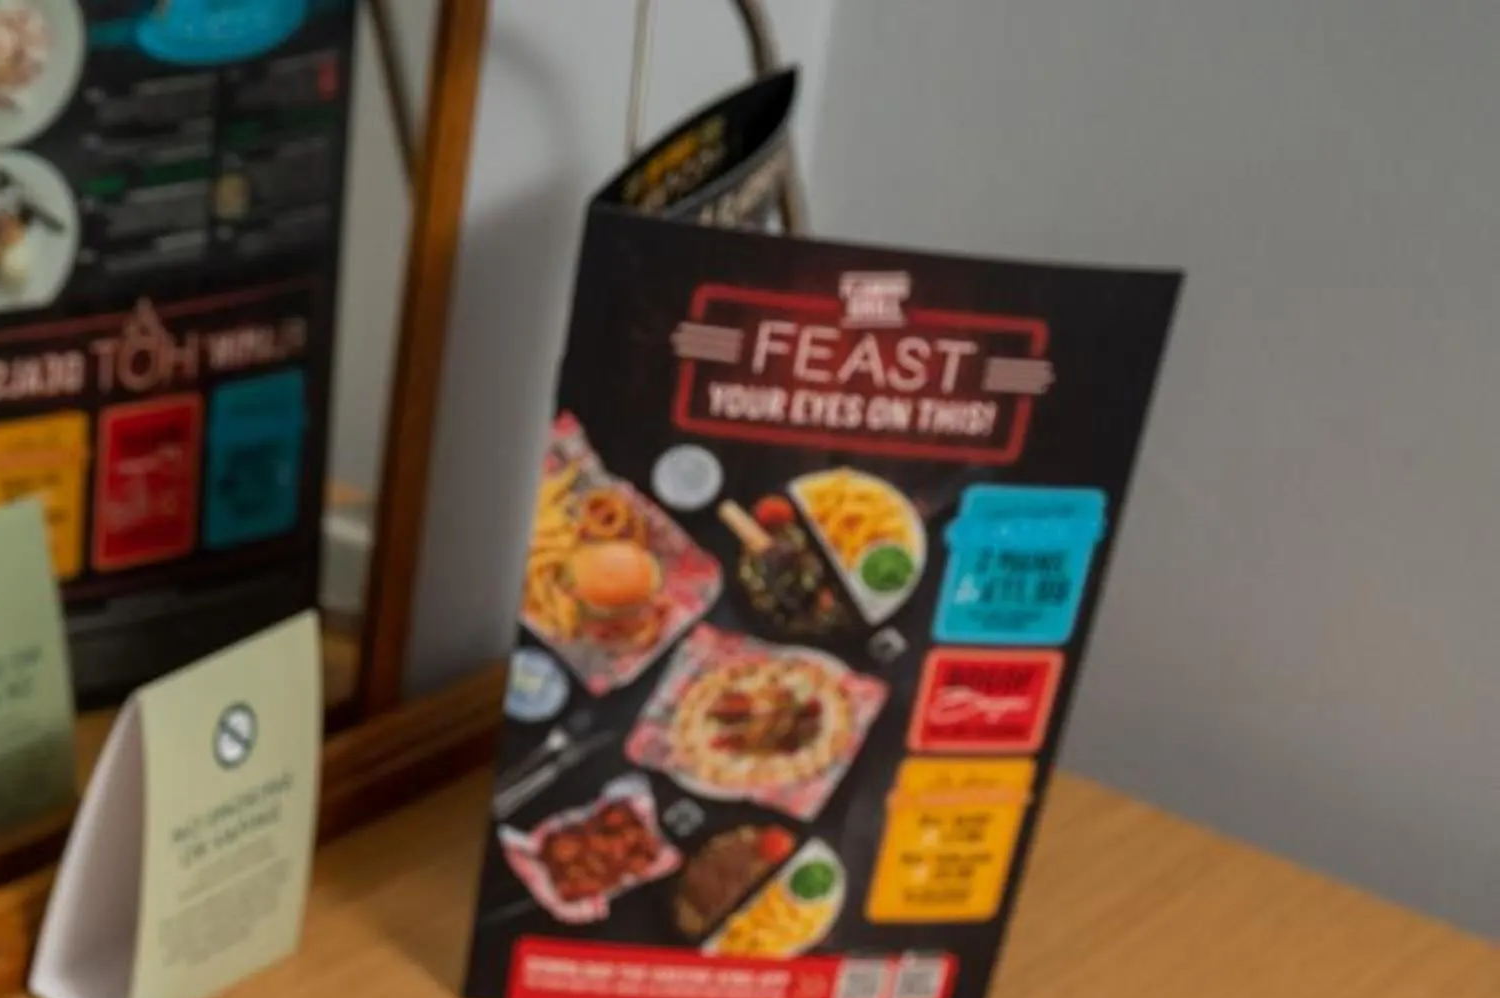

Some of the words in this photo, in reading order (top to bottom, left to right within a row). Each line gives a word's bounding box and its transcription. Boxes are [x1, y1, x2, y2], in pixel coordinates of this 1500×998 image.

[752, 320, 978, 394] FEAST
[709, 382, 788, 421] YOUR
[790, 389, 864, 430] EYES
[865, 394, 913, 431] ON
[917, 397, 998, 436] THIS!
